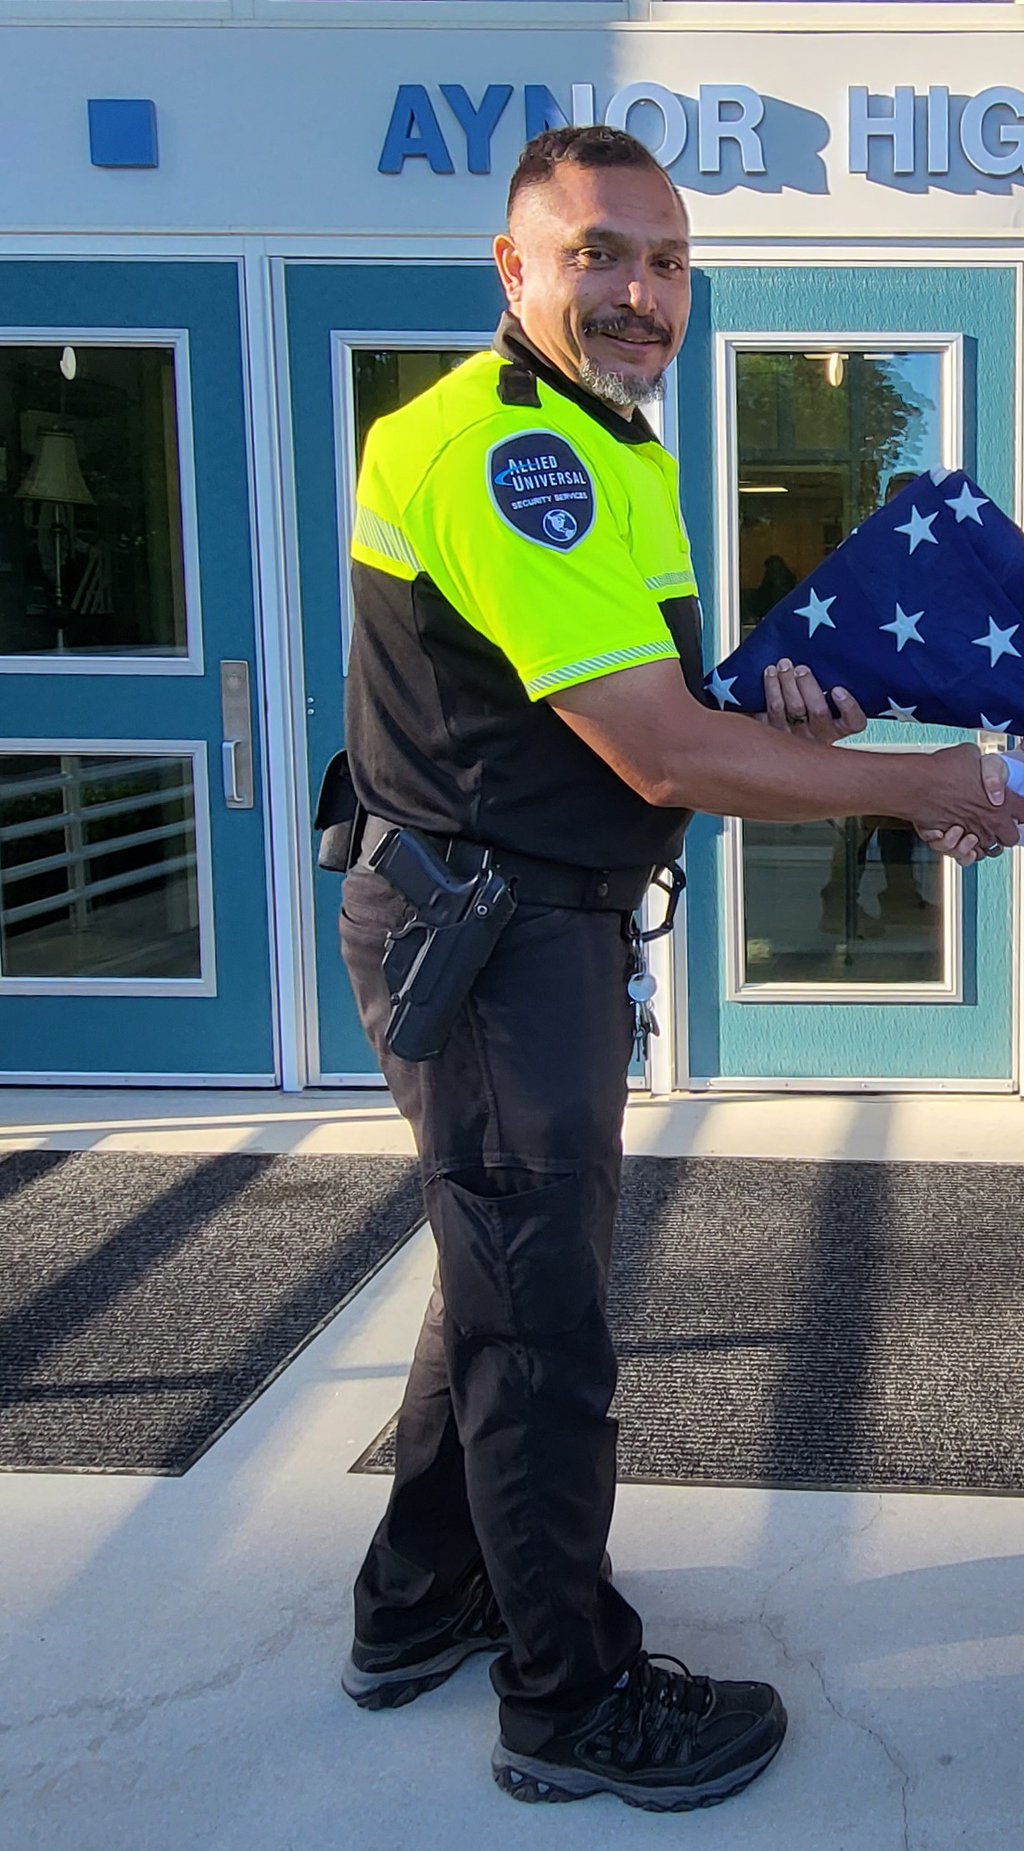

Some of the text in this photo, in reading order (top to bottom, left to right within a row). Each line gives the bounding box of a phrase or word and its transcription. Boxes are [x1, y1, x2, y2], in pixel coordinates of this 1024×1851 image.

[378, 81, 767, 174] AYNOR
[508, 455, 558, 475] ALLIED
[512, 472, 587, 492] UNIVERSAL
[511, 492, 588, 510] SECURITY SERVICES
